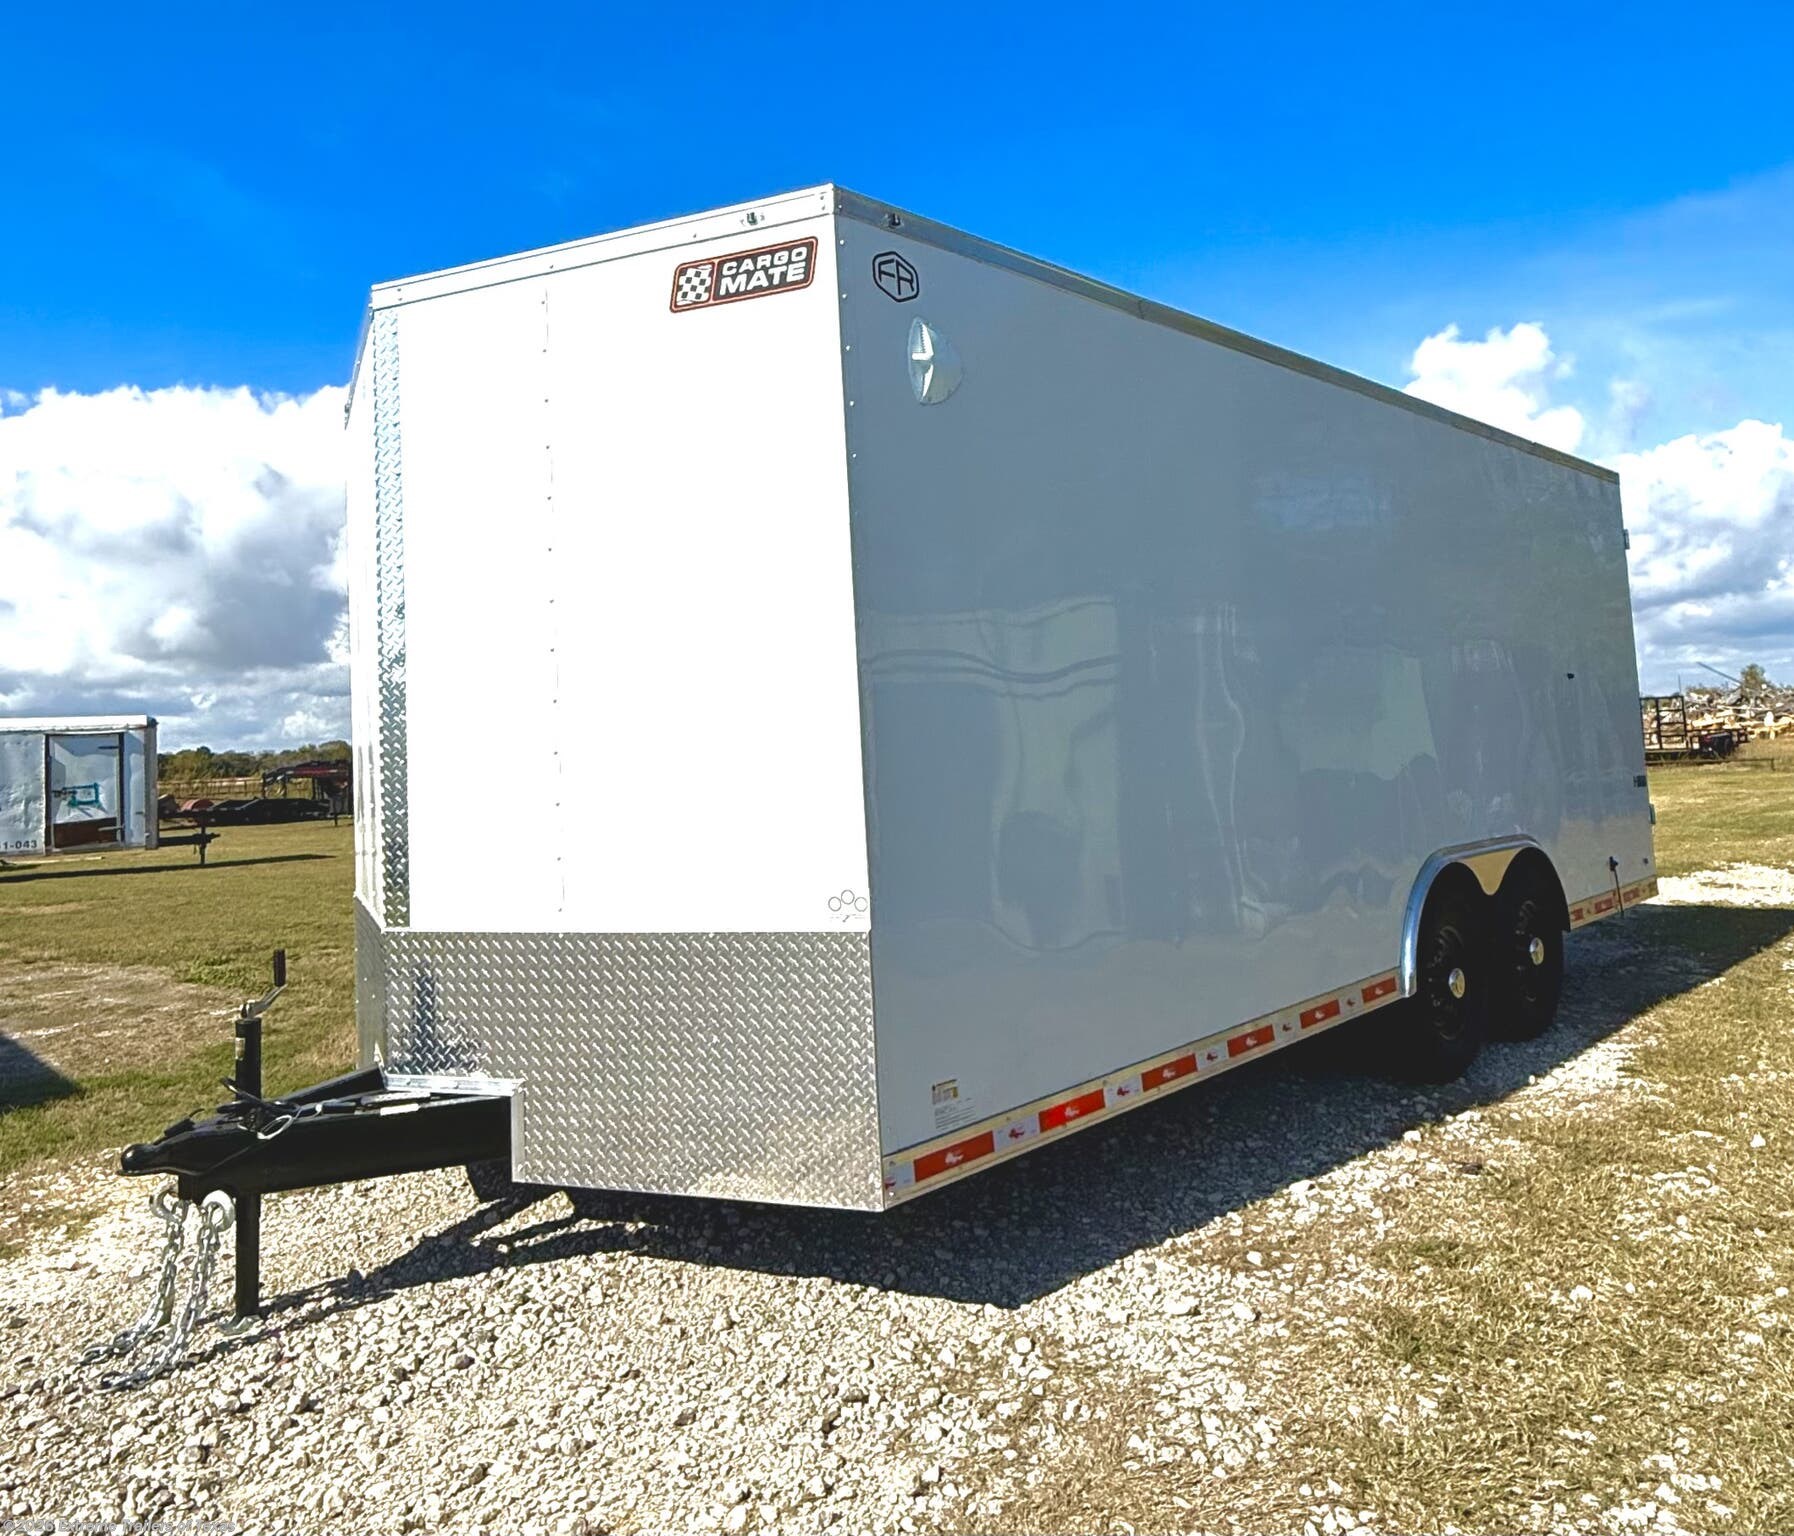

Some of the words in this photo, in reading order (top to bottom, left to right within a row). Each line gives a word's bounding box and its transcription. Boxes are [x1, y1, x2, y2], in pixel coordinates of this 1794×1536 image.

[722, 247, 807, 276] CARGO
[720, 261, 806, 296] MATE
[0, 840, 38, 850] 1-043
